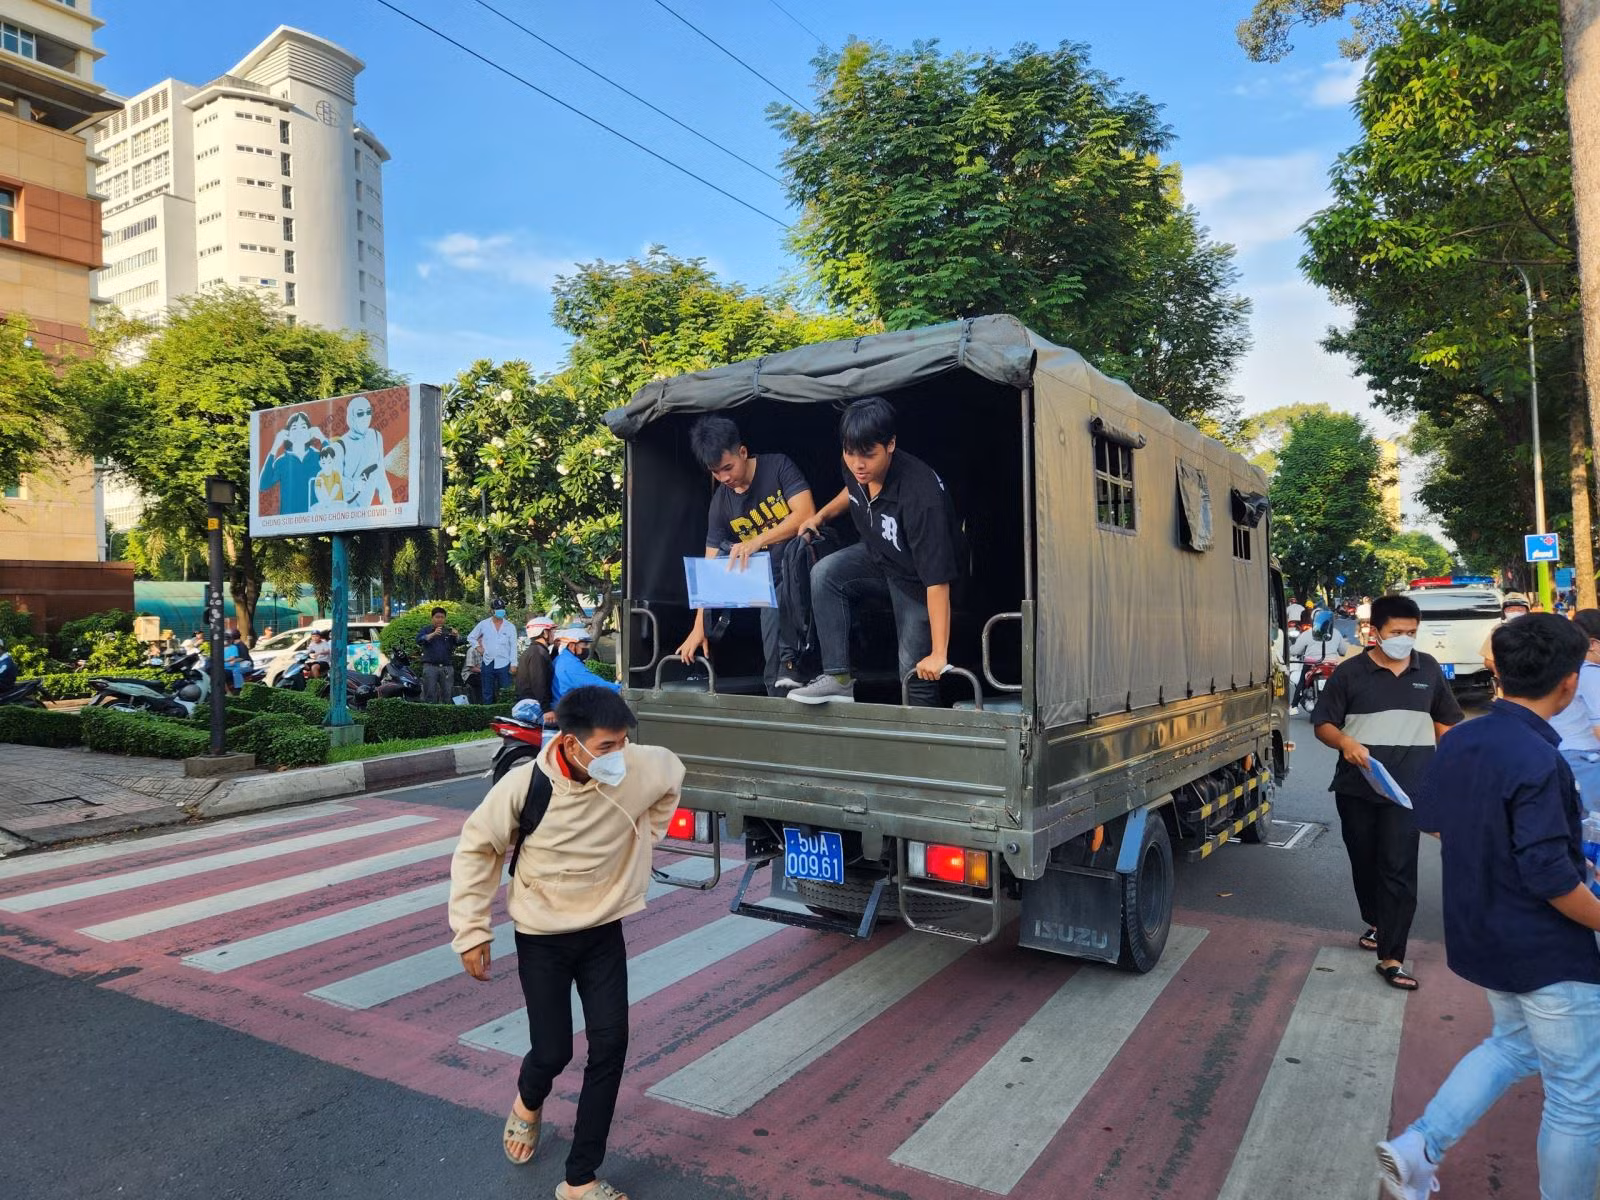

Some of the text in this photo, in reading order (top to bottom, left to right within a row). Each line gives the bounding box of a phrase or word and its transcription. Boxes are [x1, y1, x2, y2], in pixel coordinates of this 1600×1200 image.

[367, 508, 387, 518] COVID
[394, 507, 403, 515] 19
[787, 852, 839, 880] 009.61
[1034, 919, 1108, 949] ISUZU
